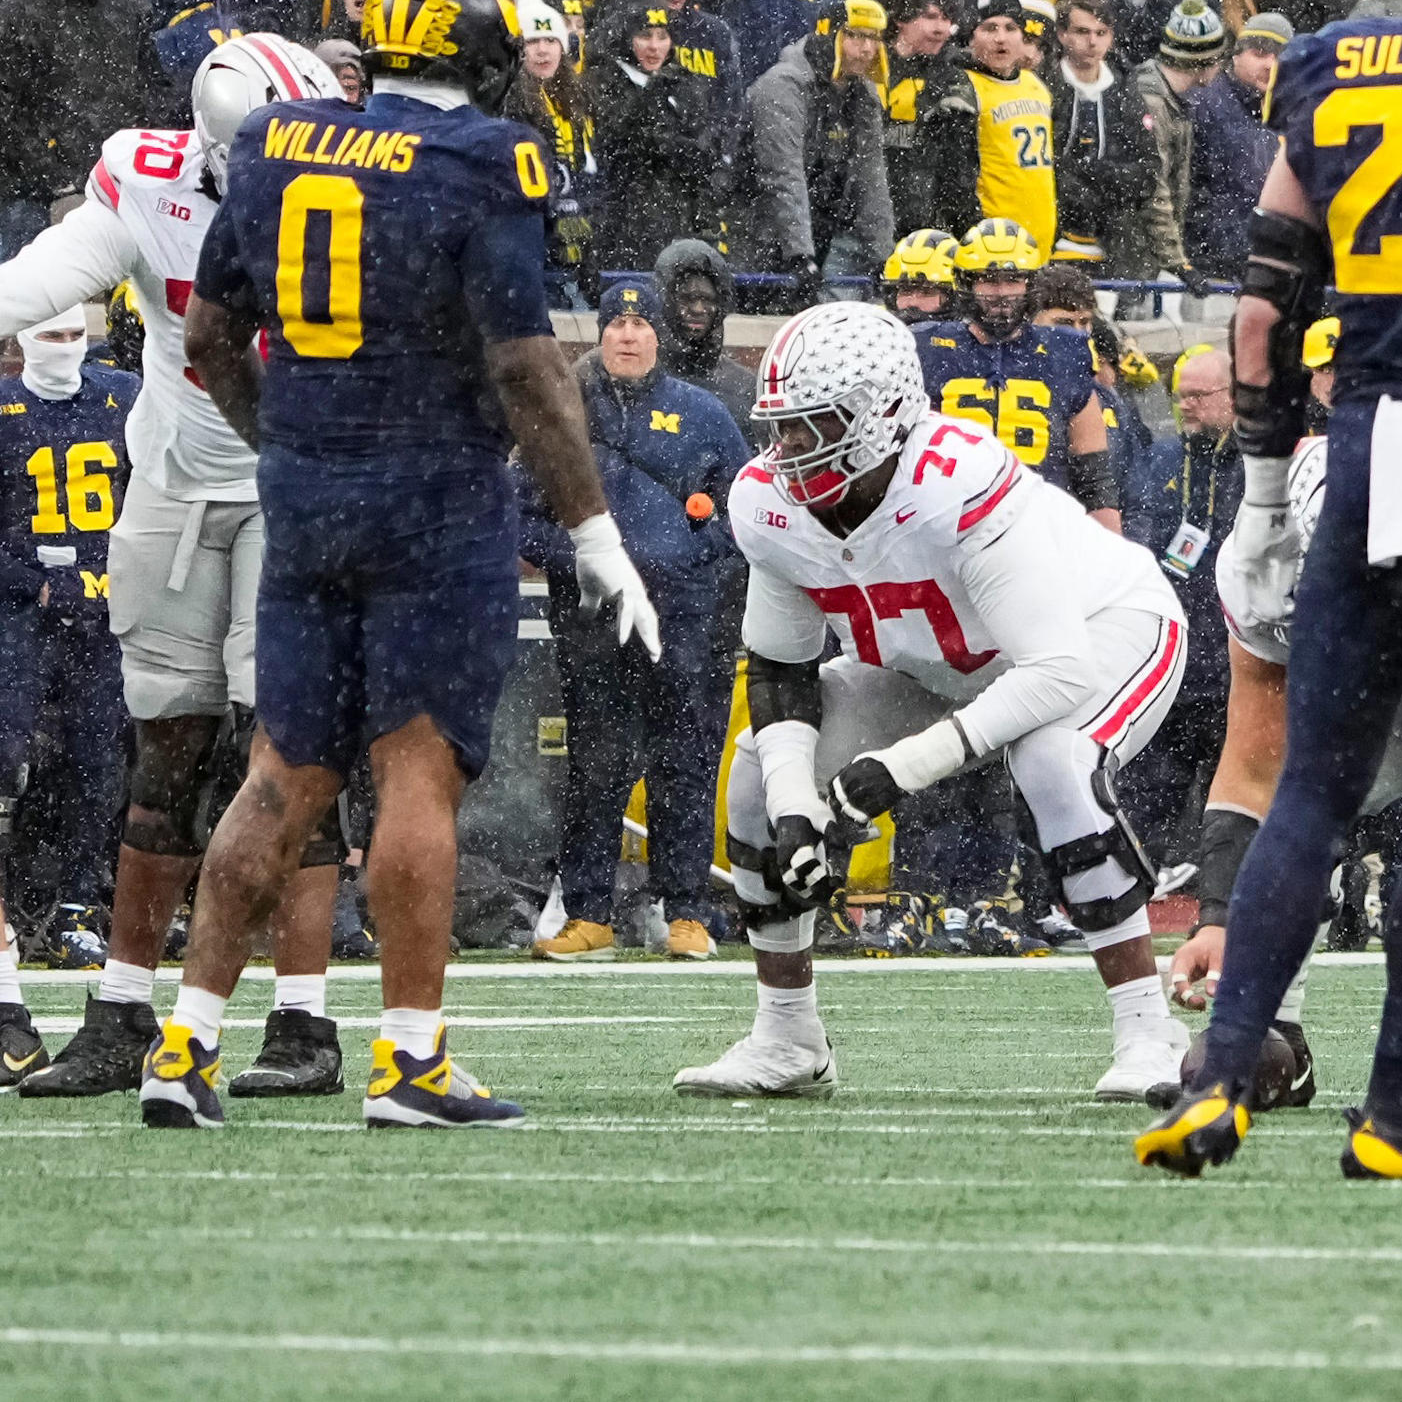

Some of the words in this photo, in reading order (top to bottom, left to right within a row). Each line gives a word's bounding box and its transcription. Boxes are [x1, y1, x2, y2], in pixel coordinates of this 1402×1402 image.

[535, 18, 553, 32] M
[646, 9, 668, 25] M
[1025, 20, 1043, 35] M
[264, 116, 423, 175] WILLIAMS
[513, 141, 550, 198] 0
[276, 171, 366, 359] 0
[941, 379, 1052, 467] 66
[912, 424, 983, 485] 77
[25, 443, 118, 535] 16
[79, 571, 109, 598] M
[800, 579, 1000, 675] 77
